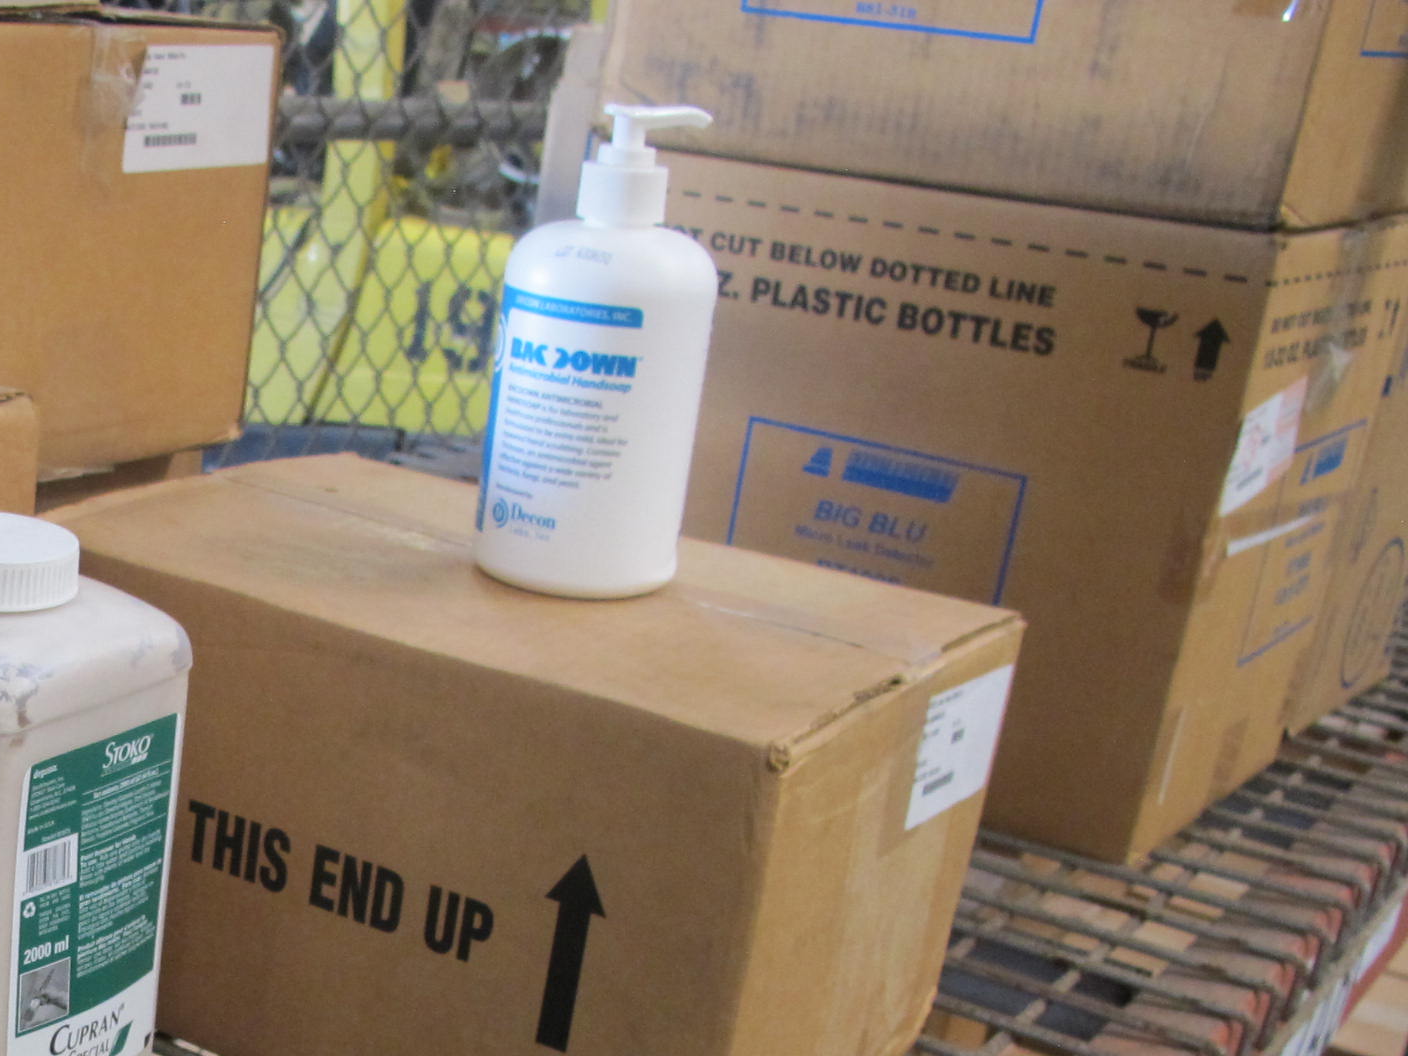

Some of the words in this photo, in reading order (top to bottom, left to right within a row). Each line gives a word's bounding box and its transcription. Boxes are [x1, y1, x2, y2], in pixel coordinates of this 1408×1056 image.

[711, 231, 762, 257] CUT
[770, 241, 863, 274] BELOW
[870, 258, 980, 294] DOTTED
[989, 278, 1057, 308] LINE
[751, 277, 888, 326] PLASTIC
[897, 302, 1057, 357] BOTTLES
[511, 503, 556, 530] Decon
[814, 498, 863, 529] BIG
[868, 512, 928, 543] BLU
[102, 734, 151, 769] STOKO
[189, 799, 291, 894] THIS
[308, 844, 405, 934] END
[423, 884, 495, 963] UP
[23, 942, 52, 965] 2000
[54, 935, 69, 954] ml
[49, 1010, 120, 1056] CUPRAN
